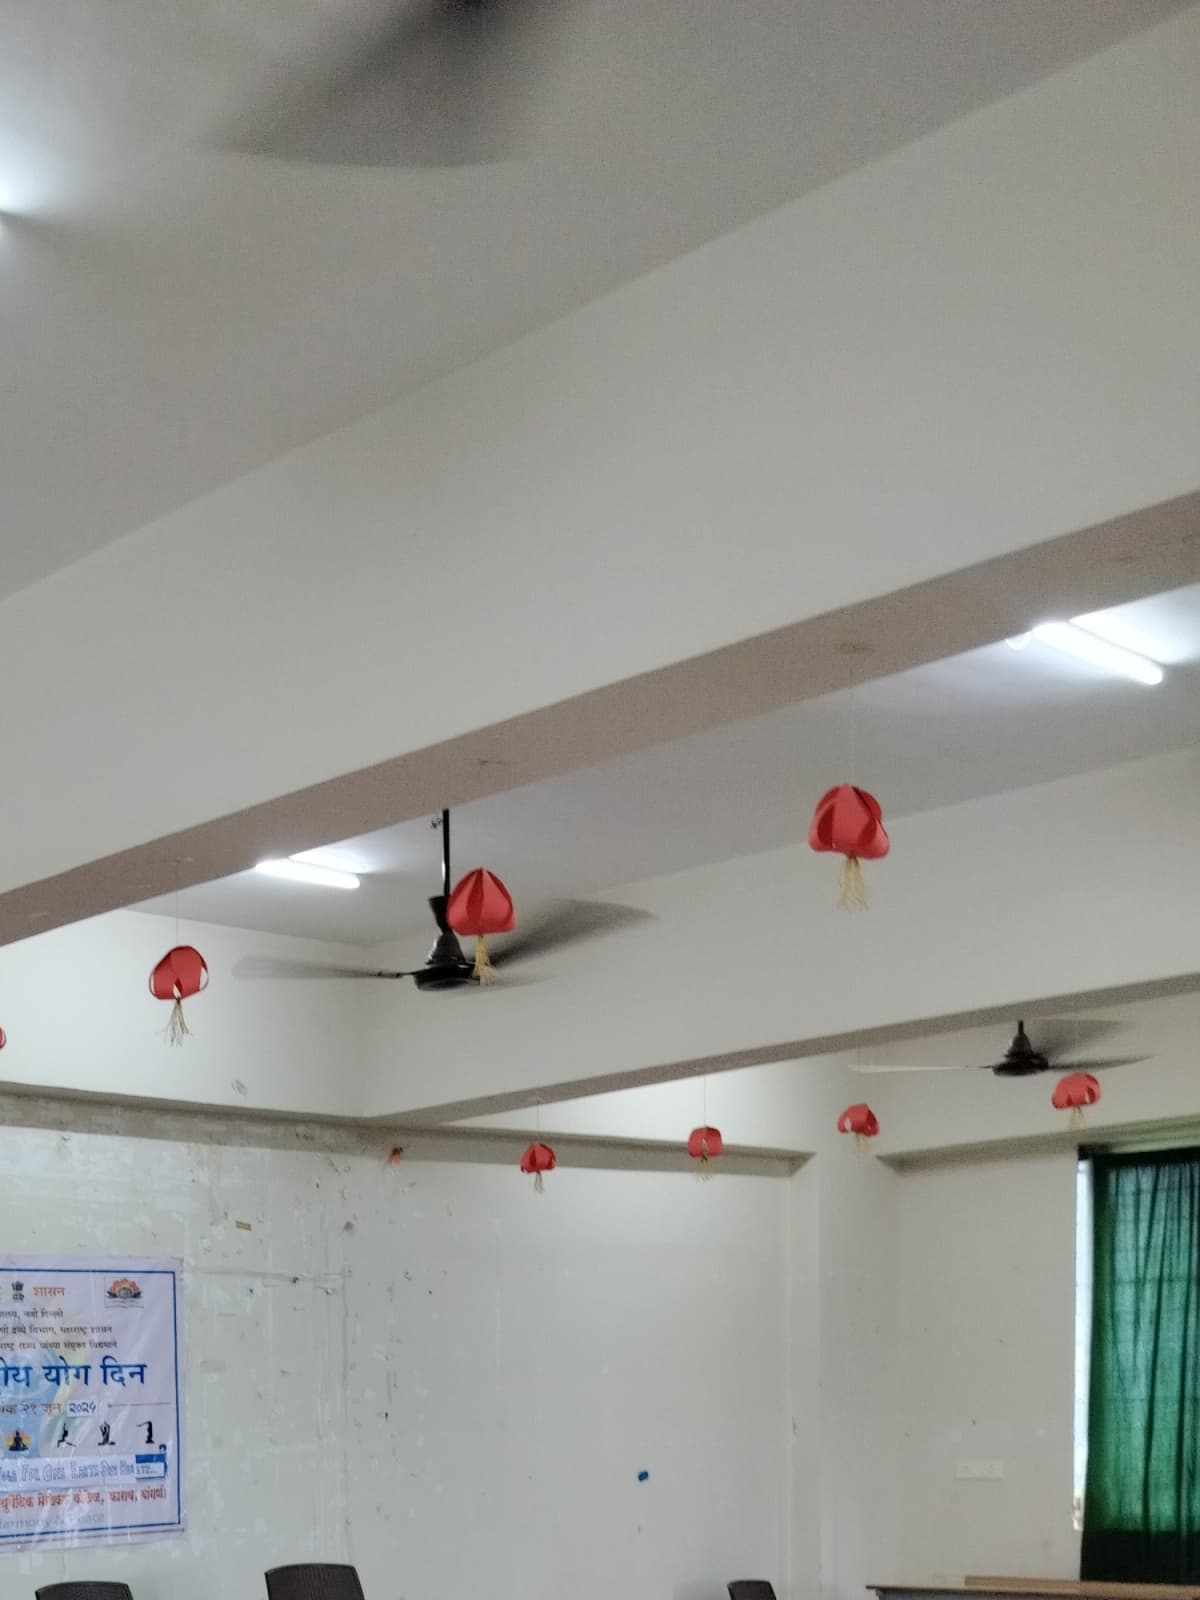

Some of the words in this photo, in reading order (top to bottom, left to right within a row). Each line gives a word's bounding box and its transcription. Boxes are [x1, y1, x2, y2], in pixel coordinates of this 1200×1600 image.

[32, 1286, 65, 1297] शासन
[42, 1356, 92, 1386] योग
[100, 1355, 148, 1386] दिन
